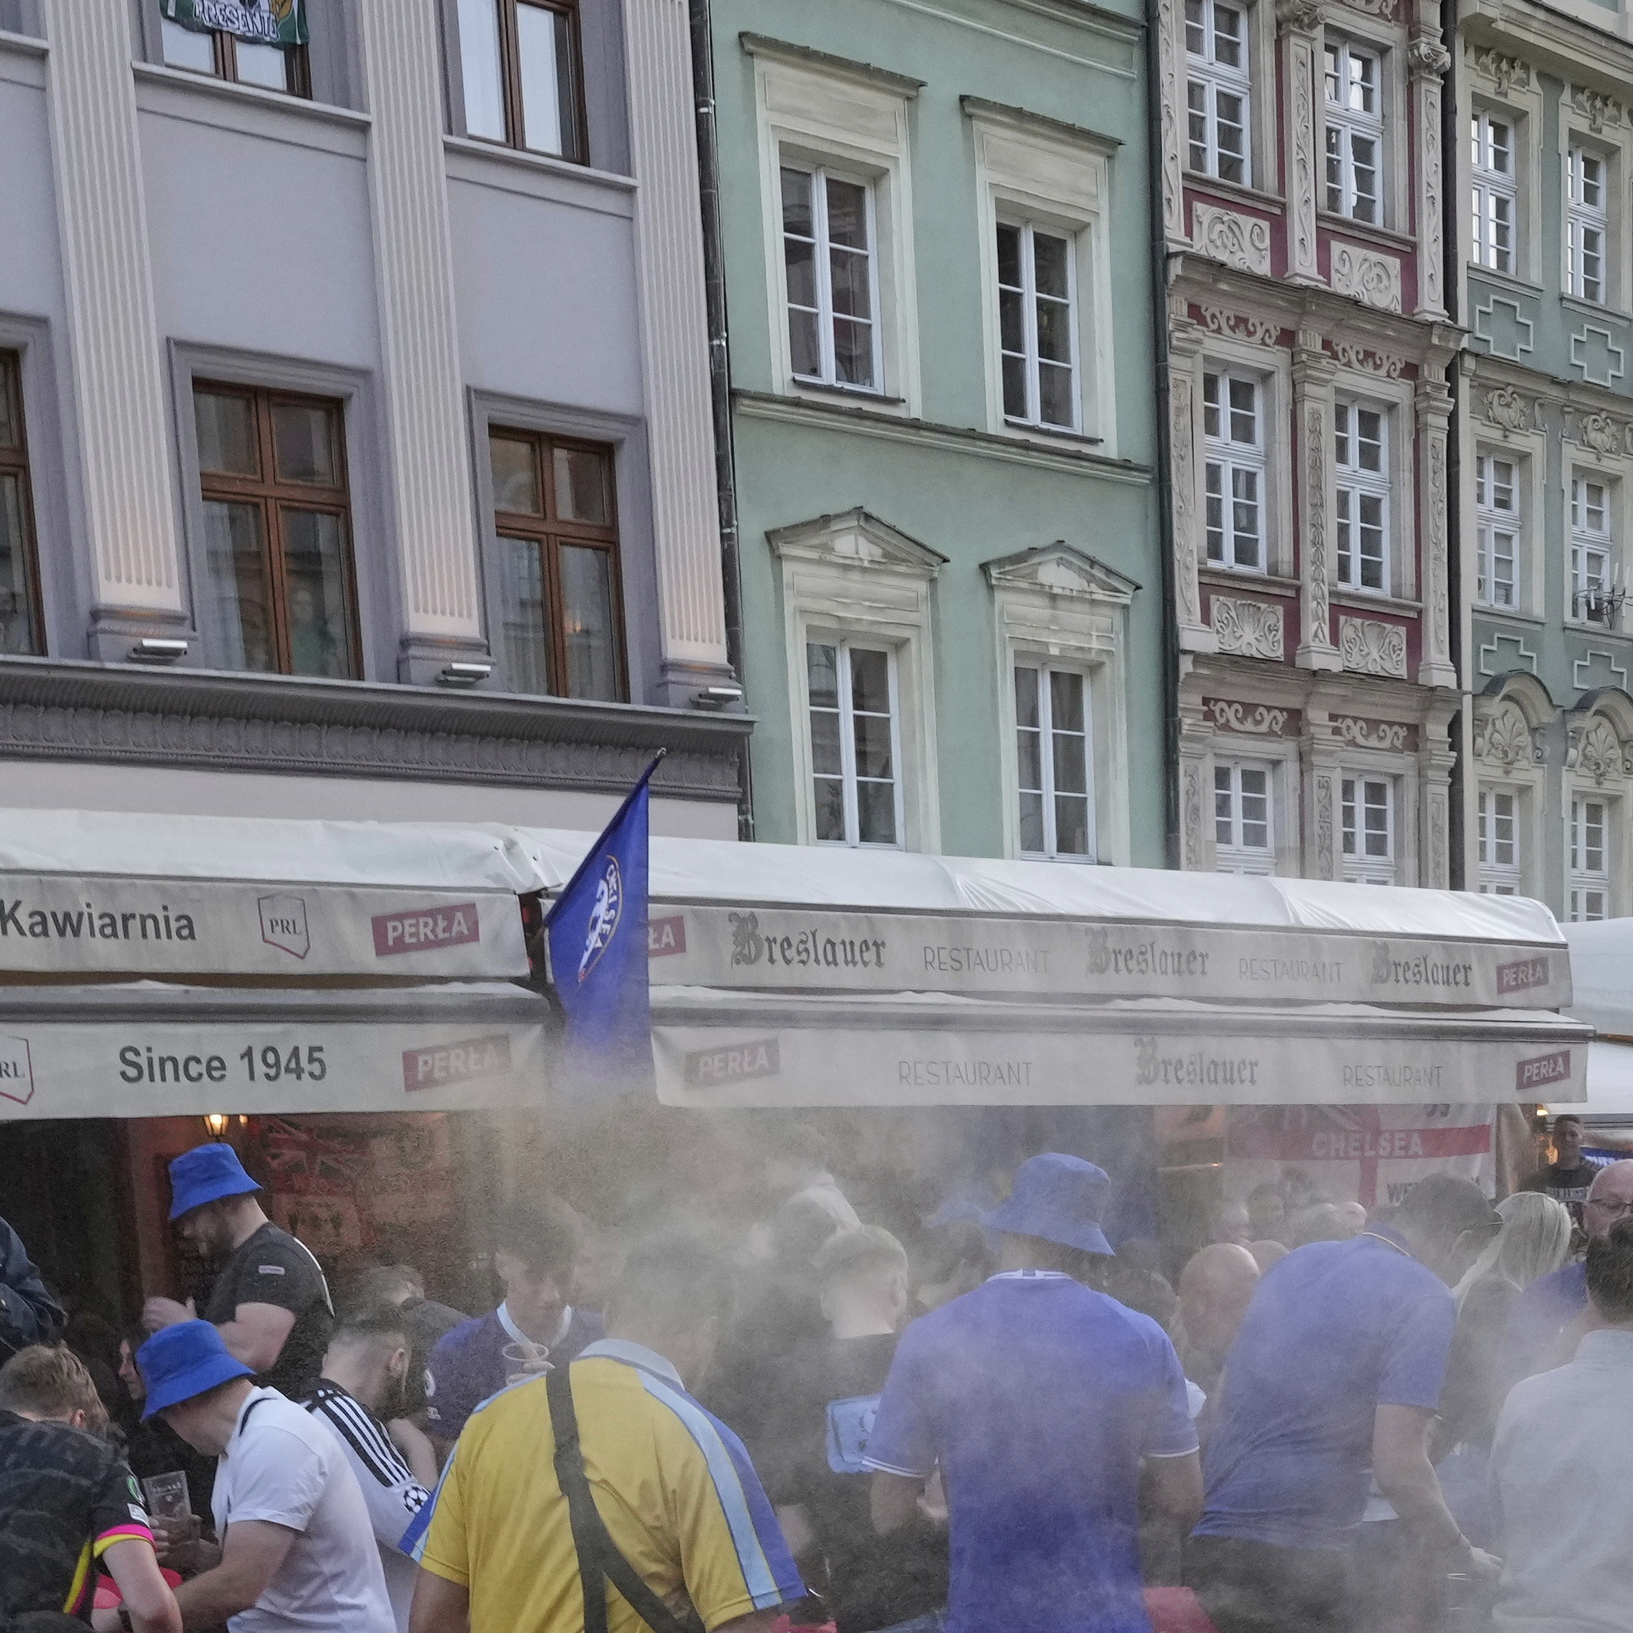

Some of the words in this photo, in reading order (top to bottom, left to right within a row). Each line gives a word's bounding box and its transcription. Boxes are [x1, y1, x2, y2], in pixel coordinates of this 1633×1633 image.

[268, 916, 303, 936] PRL
[386, 908, 469, 946] PERŁA
[727, 910, 888, 970] Breslauer
[923, 945, 1051, 974] RESTAURANT
[1084, 924, 1211, 977] Breslauer
[1238, 956, 1344, 984] RESTAURANT
[1369, 940, 1474, 988] Breslauer
[1501, 959, 1545, 987] PERŁA
[118, 1045, 228, 1084] Since
[239, 1045, 328, 1083] 1945
[415, 1042, 503, 1084] PERŁA
[697, 1046, 771, 1079] PERŁA
[898, 1060, 1034, 1087] RESTAURANT
[1133, 1036, 1260, 1087] Breslauer
[1343, 1065, 1444, 1089] RESTAURANT
[1523, 1054, 1565, 1084] PERŁA
[1311, 1130, 1424, 1160] CHELSEA
